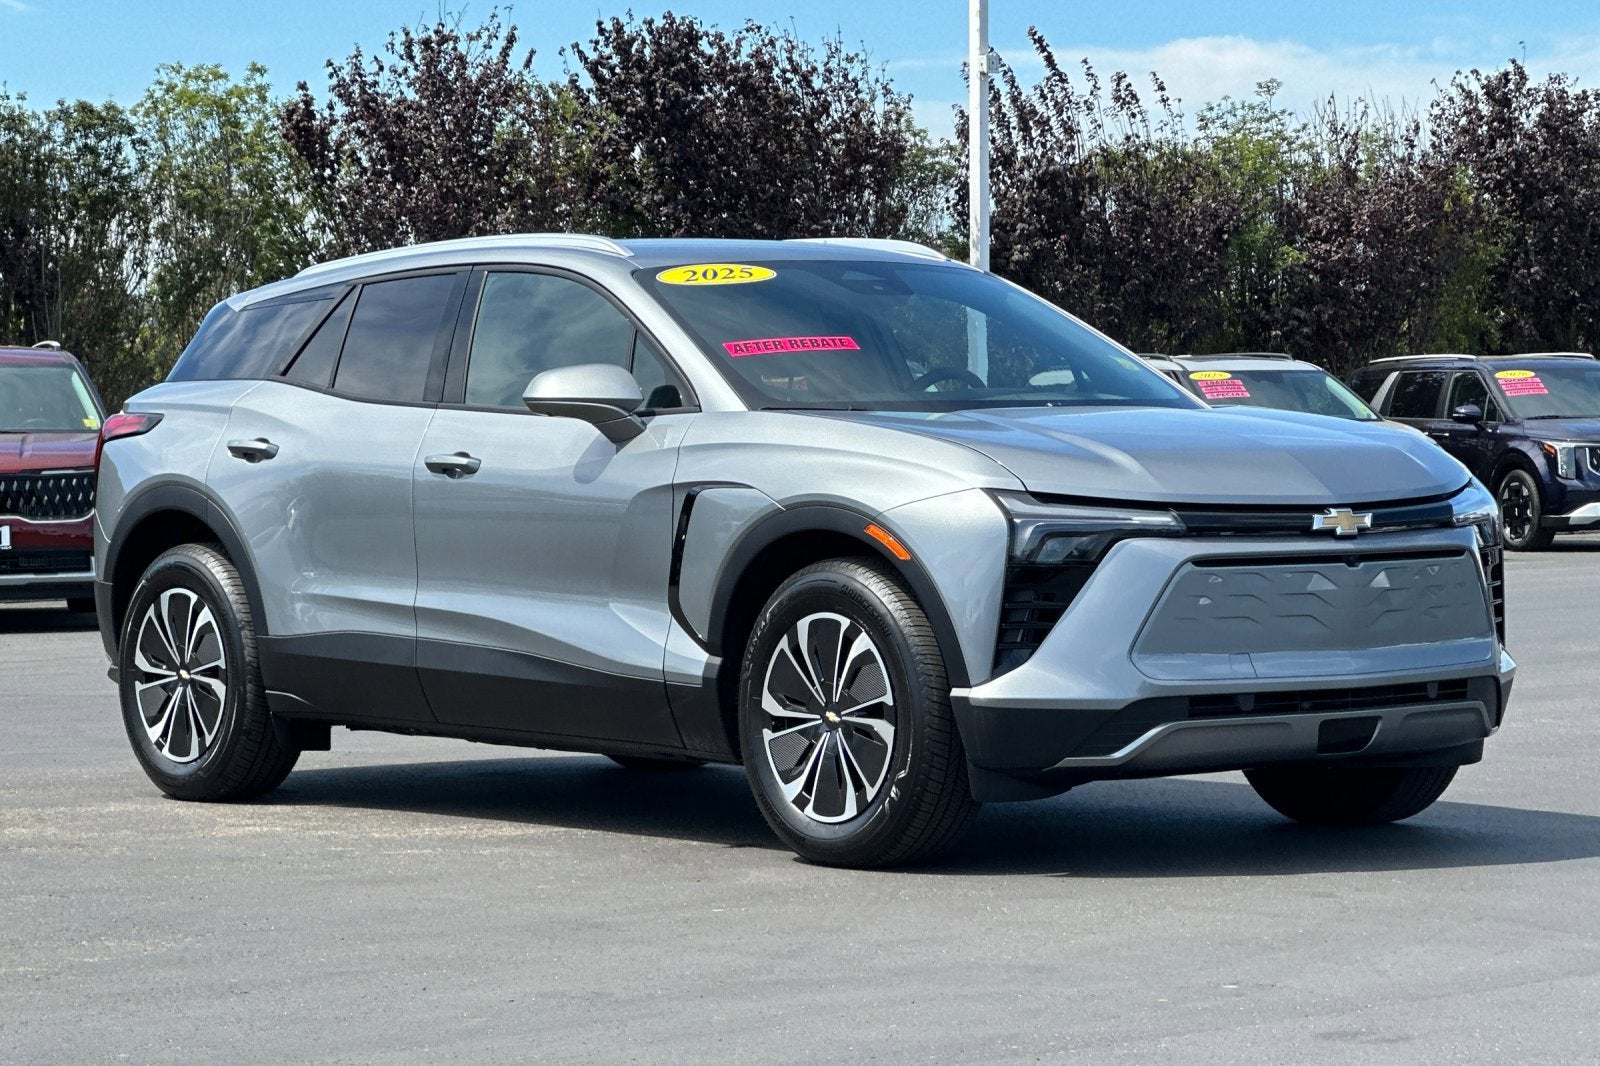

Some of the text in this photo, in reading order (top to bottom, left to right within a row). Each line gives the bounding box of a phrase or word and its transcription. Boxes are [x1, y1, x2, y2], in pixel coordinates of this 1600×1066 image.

[683, 267, 753, 282] 2025
[733, 337, 849, 354] AFTER REBATE
